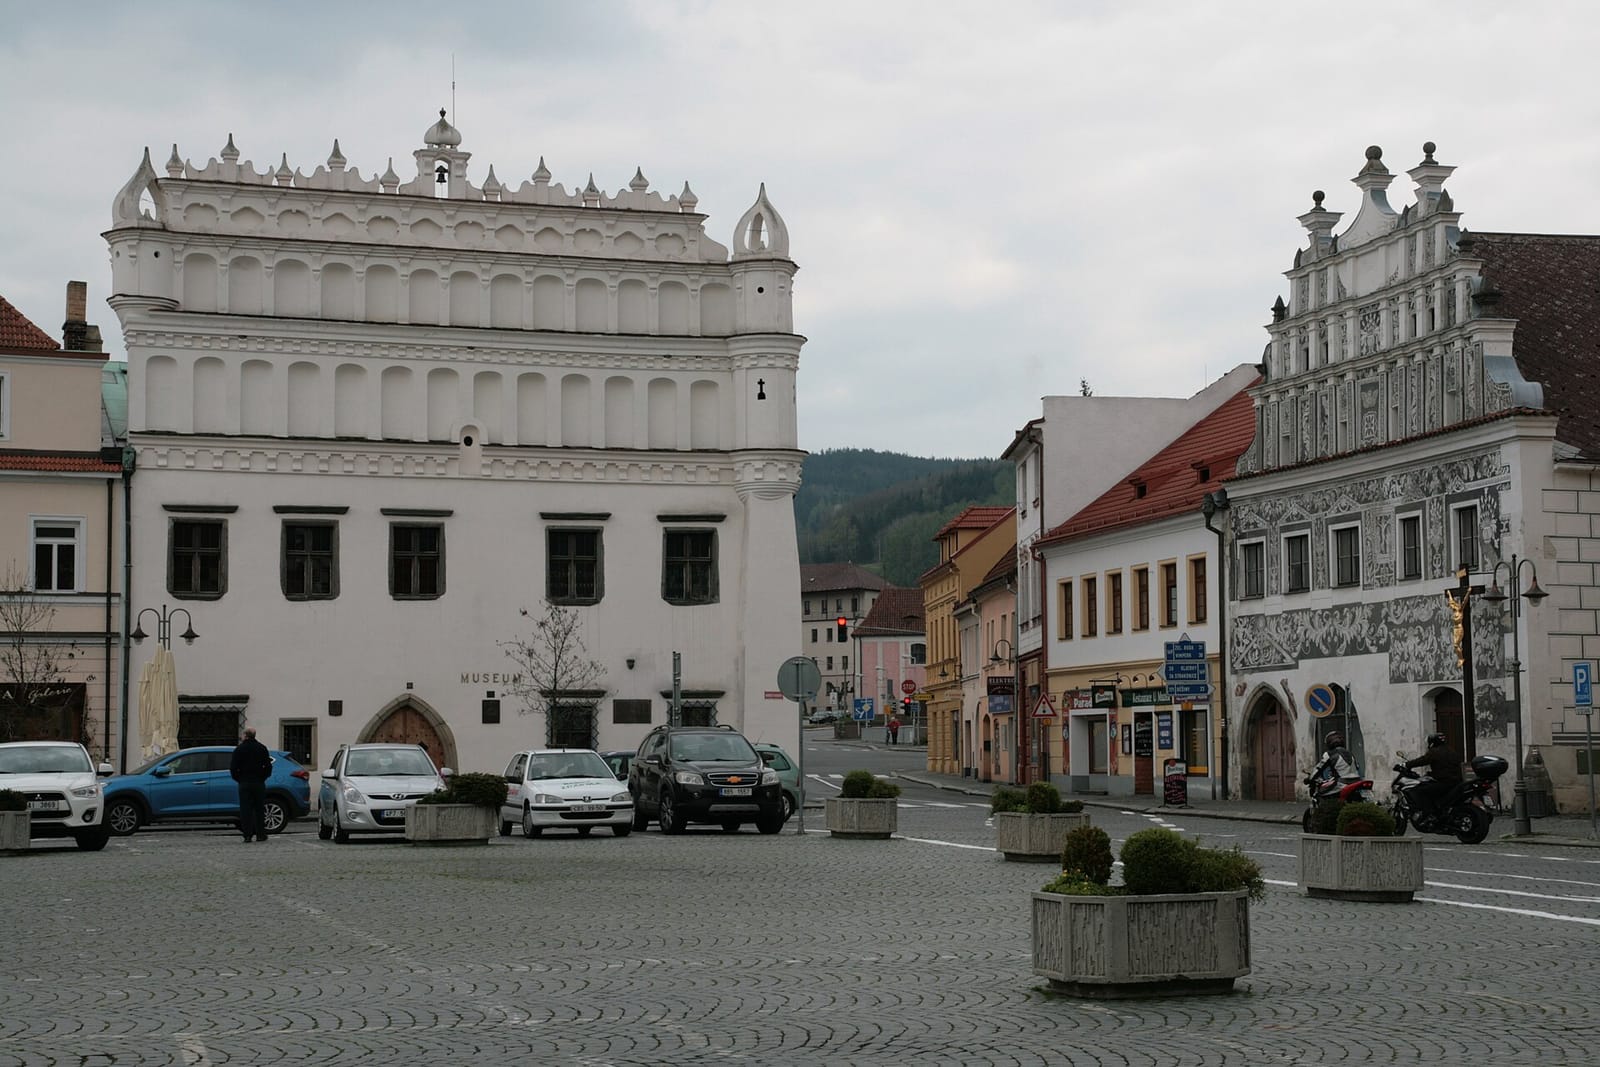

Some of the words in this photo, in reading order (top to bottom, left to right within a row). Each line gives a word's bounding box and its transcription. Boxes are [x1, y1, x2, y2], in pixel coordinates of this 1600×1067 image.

[461, 672, 522, 684] MUSEUM
[1576, 668, 1587, 692] P
[902, 683, 915, 691] STOP
[28, 686, 73, 705] Galerie
